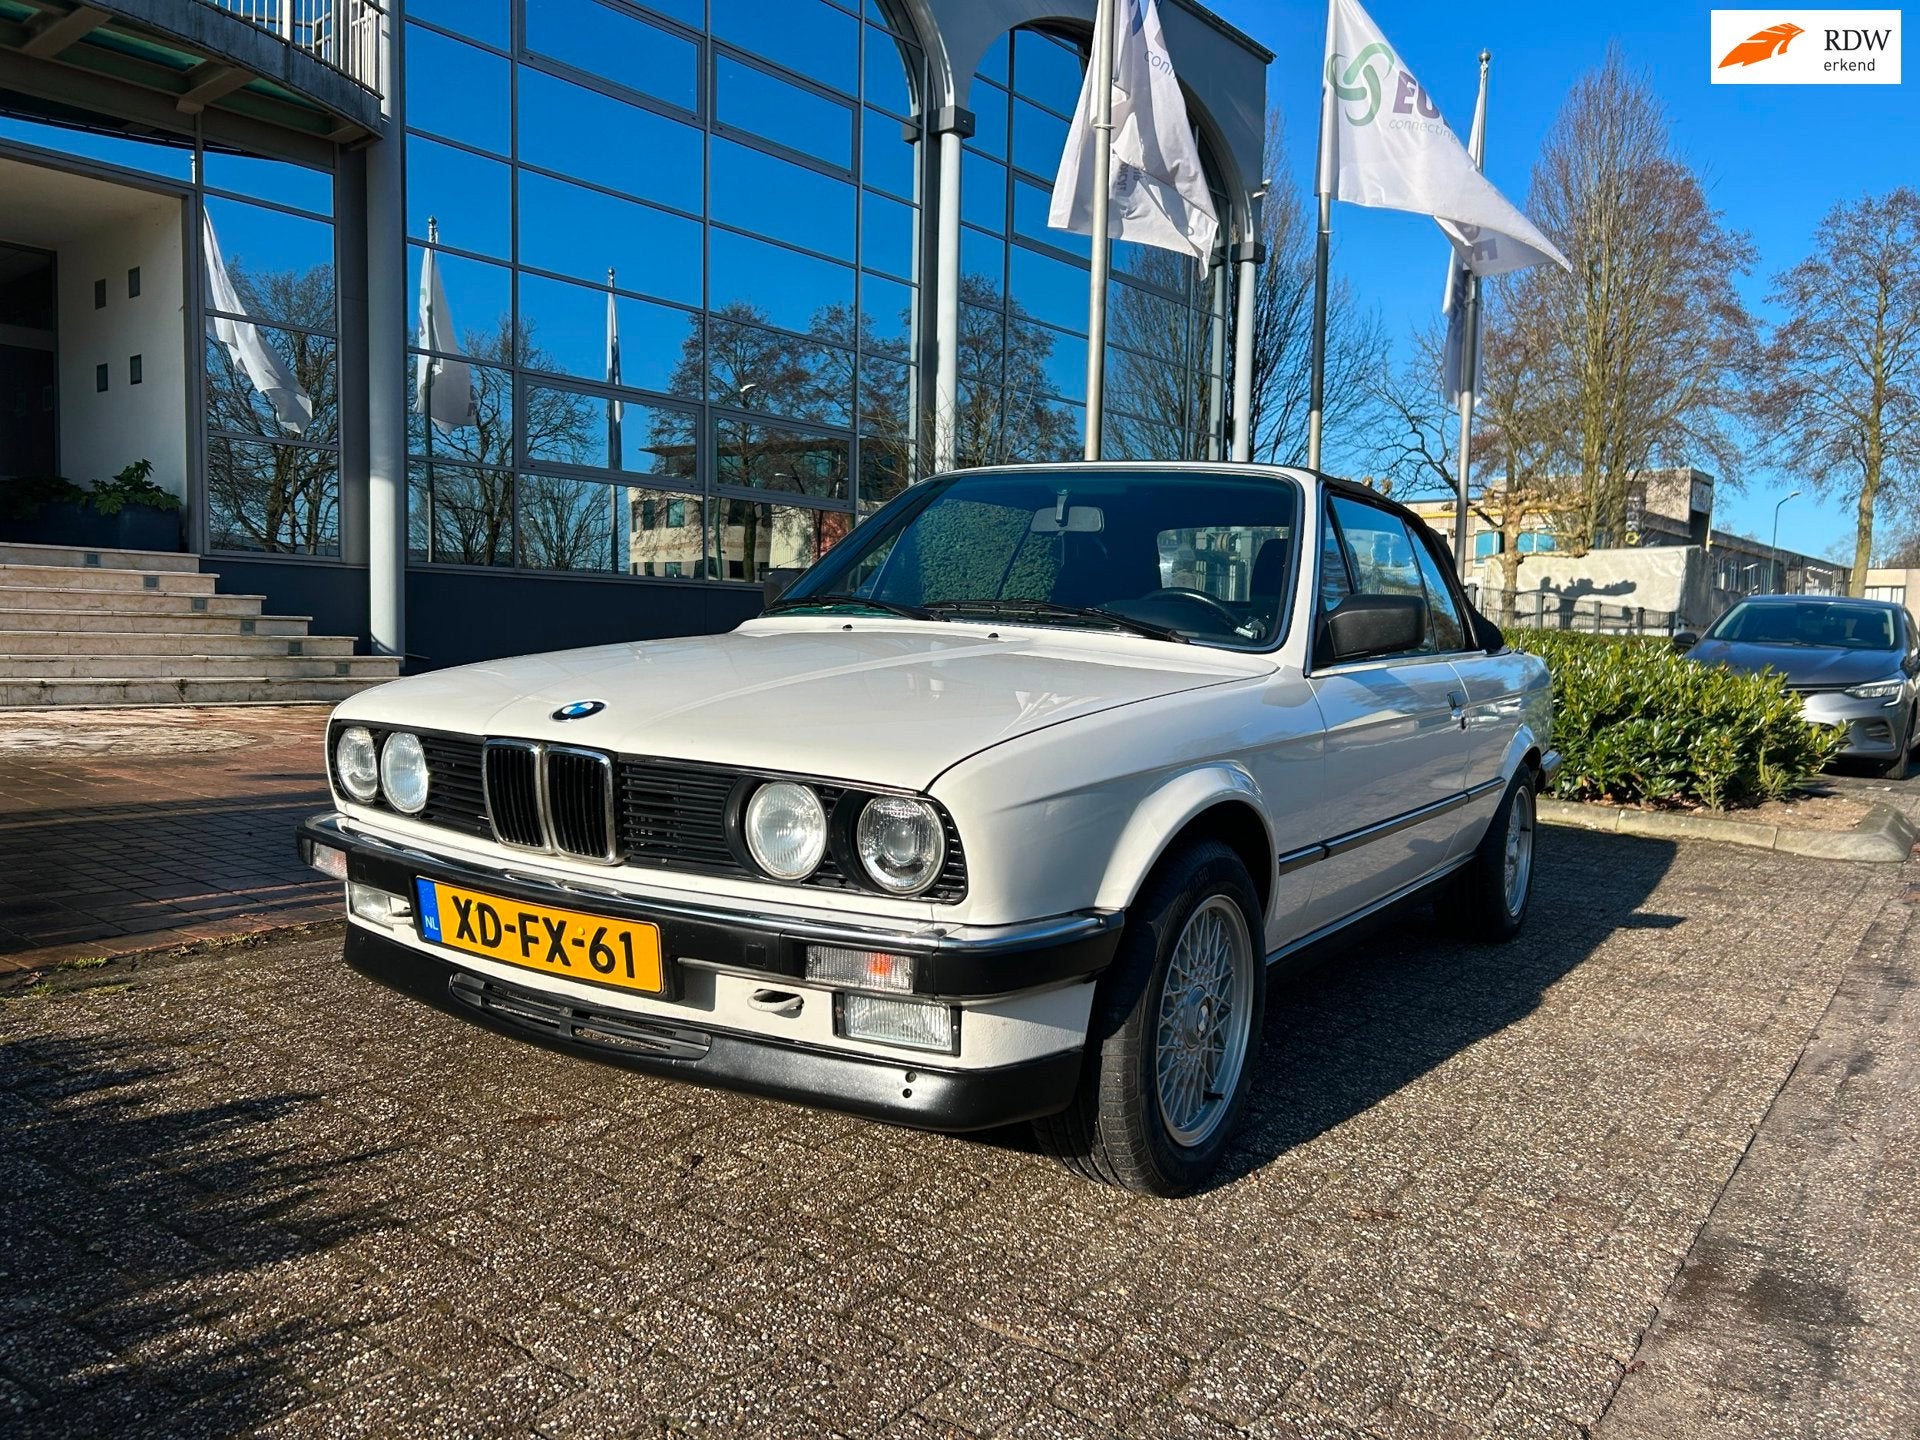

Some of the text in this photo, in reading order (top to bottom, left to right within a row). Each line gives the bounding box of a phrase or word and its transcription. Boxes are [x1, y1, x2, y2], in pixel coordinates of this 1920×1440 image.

[1392, 70, 1451, 129] EU
[424, 914, 439, 931] NL
[451, 895, 635, 979] XD-FX-61
